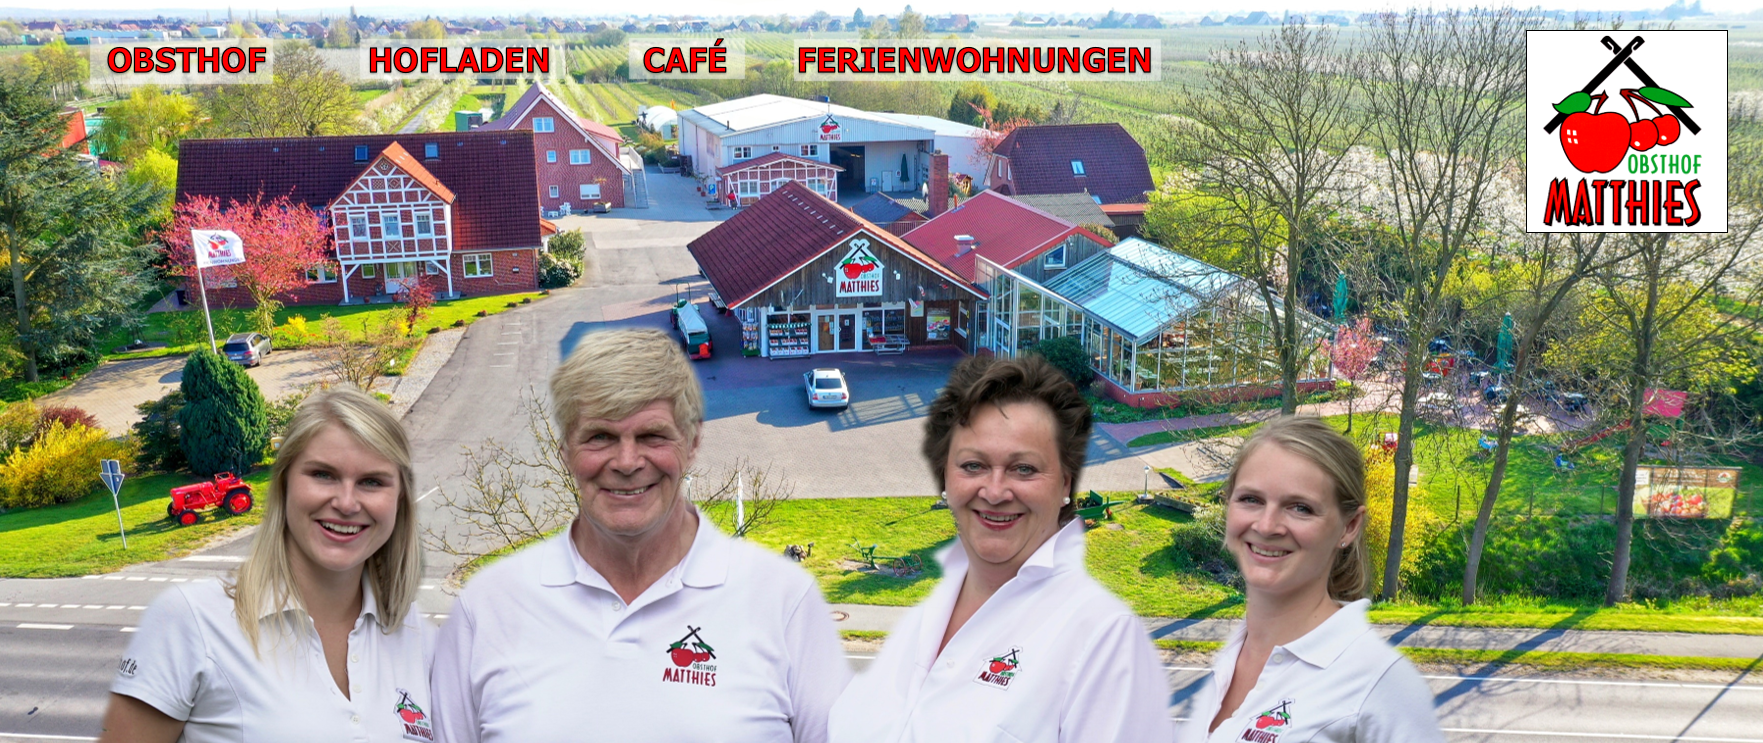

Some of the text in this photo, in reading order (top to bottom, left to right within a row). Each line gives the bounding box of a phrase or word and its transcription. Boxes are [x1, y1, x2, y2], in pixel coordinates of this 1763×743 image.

[839, 279, 880, 293] MATTHIES
[692, 662, 717, 672] OBSTHOF
[662, 667, 717, 687] MATTHIES
